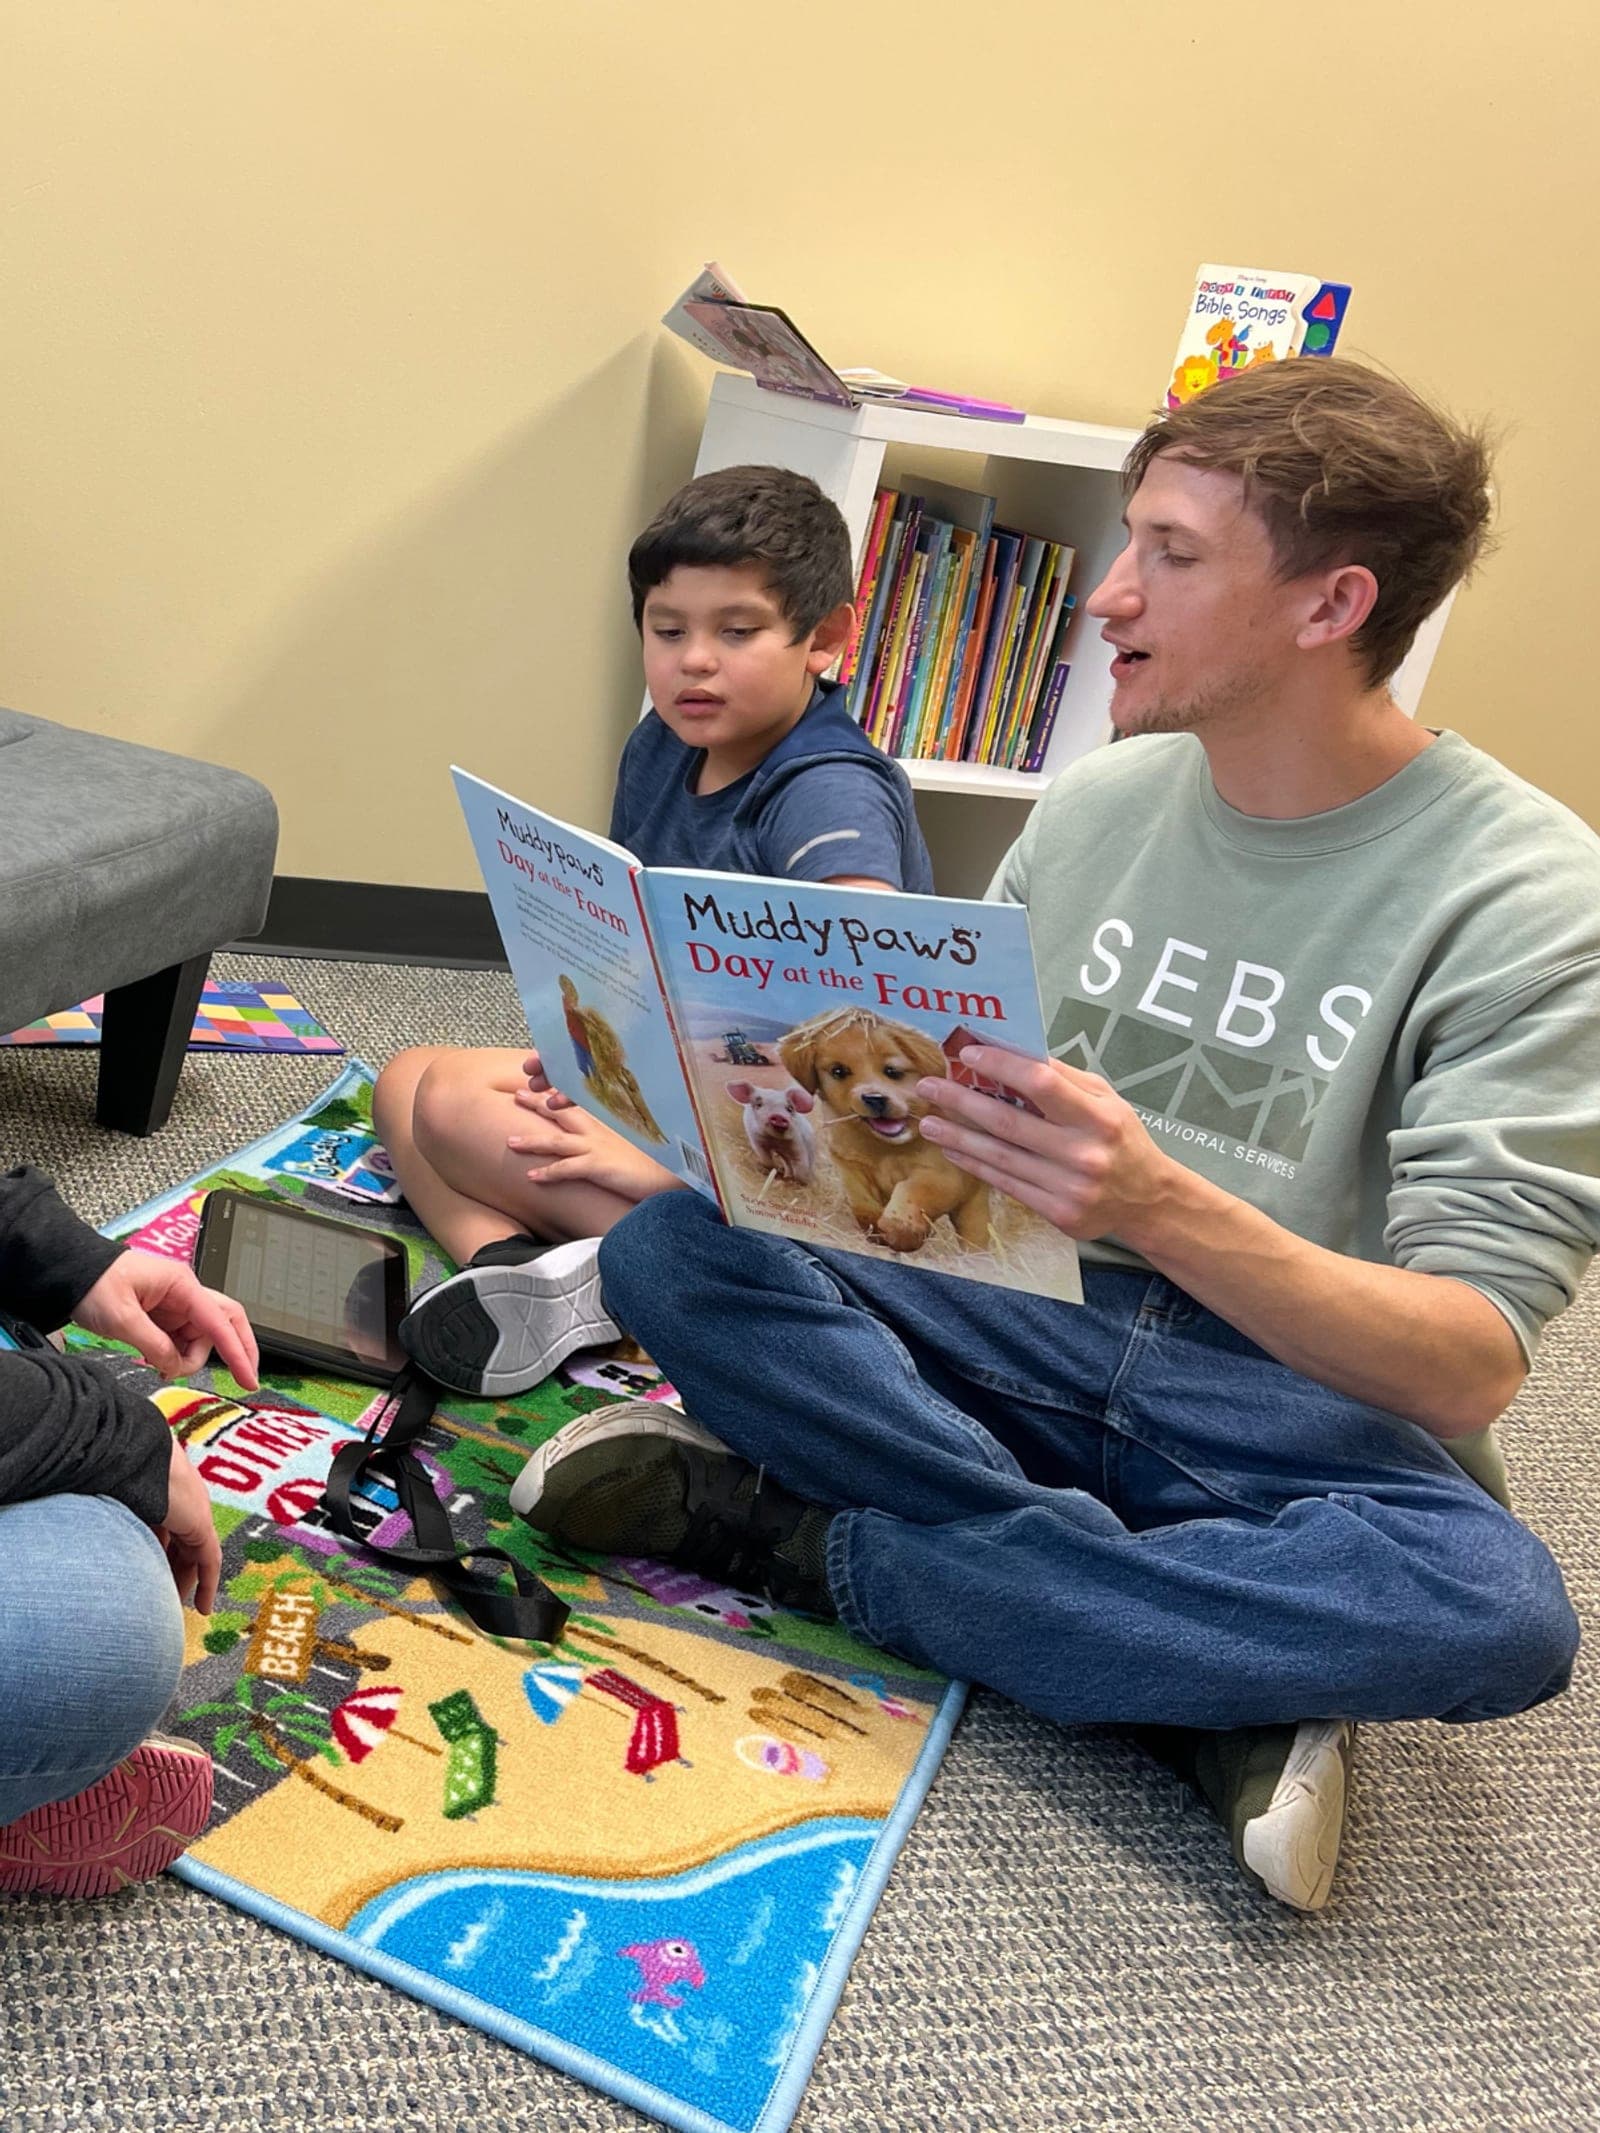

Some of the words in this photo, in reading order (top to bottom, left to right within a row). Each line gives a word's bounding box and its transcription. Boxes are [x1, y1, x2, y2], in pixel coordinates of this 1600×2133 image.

[1195, 293, 1232, 315] Bible
[1238, 300, 1287, 326] Songs
[497, 839, 535, 883] Day
[538, 871, 551, 886] at
[552, 876, 573, 898] the
[573, 887, 631, 937] Farm
[685, 941, 775, 989] Day
[782, 966, 812, 985] at
[818, 967, 864, 991] the
[873, 973, 1008, 1021] Farm
[1080, 918, 1373, 1071] SEBS
[1134, 1109, 1227, 1154] HAVIORAL
[1233, 1145, 1296, 1180] SERVICES
[140, 1212, 200, 1254] Hair
[197, 1414, 330, 1495] DINER
[259, 1592, 315, 1678] BEACH
